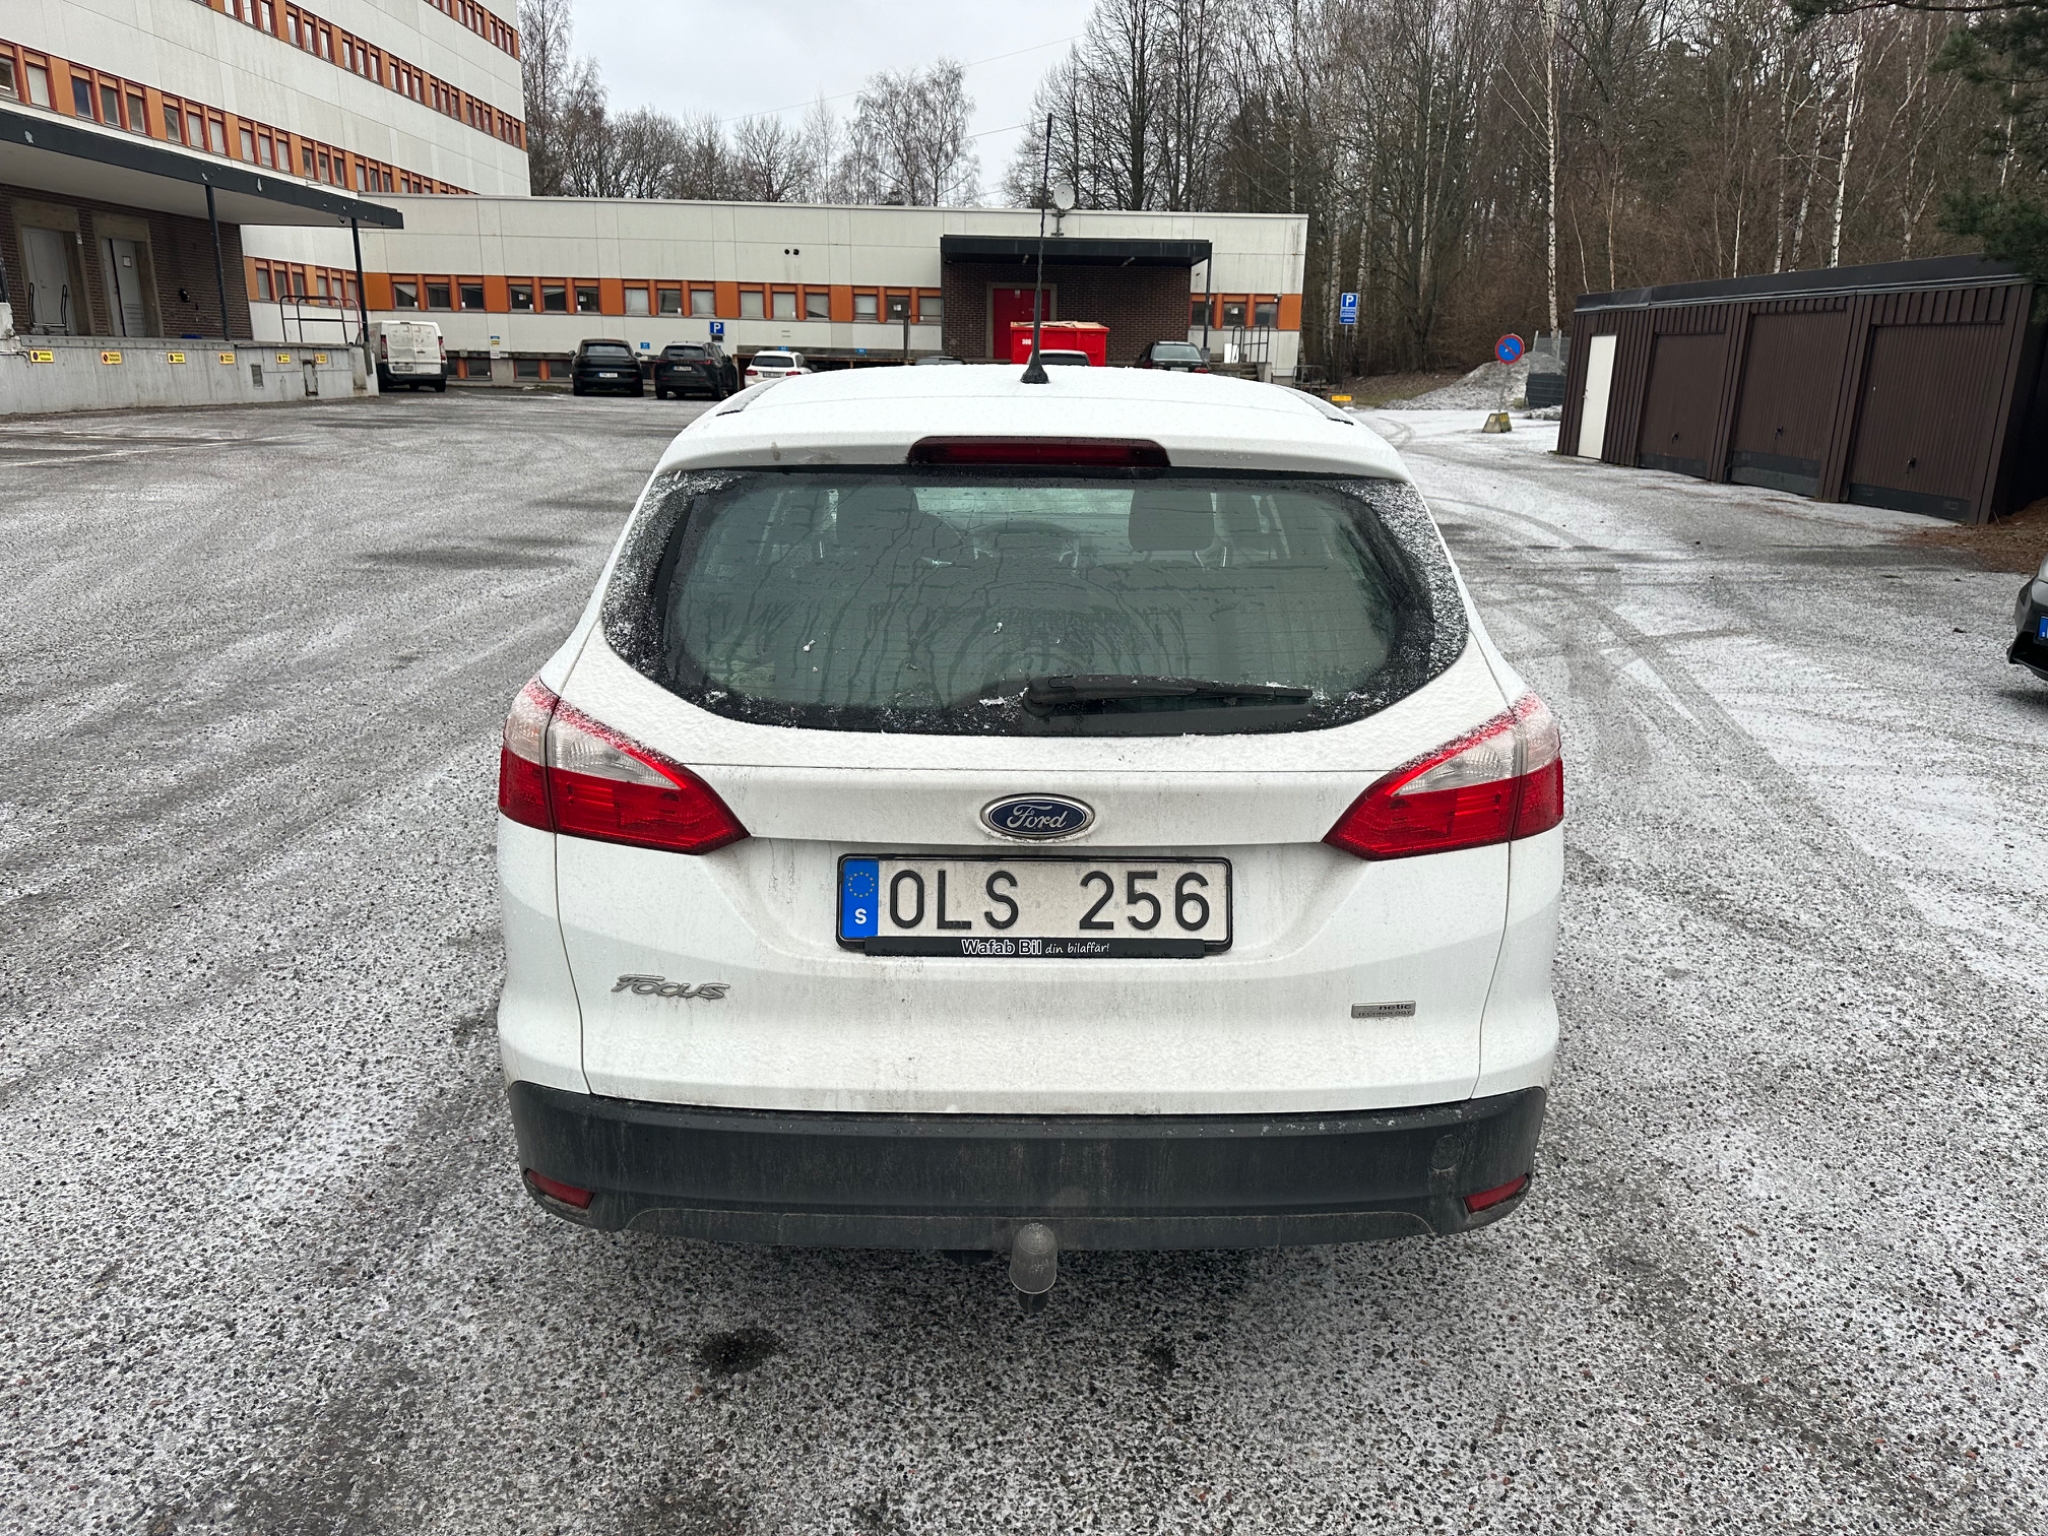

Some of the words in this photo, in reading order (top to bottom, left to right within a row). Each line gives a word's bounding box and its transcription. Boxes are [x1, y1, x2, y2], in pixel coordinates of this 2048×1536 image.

[1346, 295, 1354, 307] P
[714, 322, 721, 333] P
[1005, 803, 1067, 830] Ford
[889, 869, 1020, 931] OLS
[1078, 870, 1211, 932] 256
[854, 907, 867, 925] S
[961, 939, 1015, 955] Wafab
[1019, 939, 1042, 955] Bil
[1045, 943, 1064, 954] din
